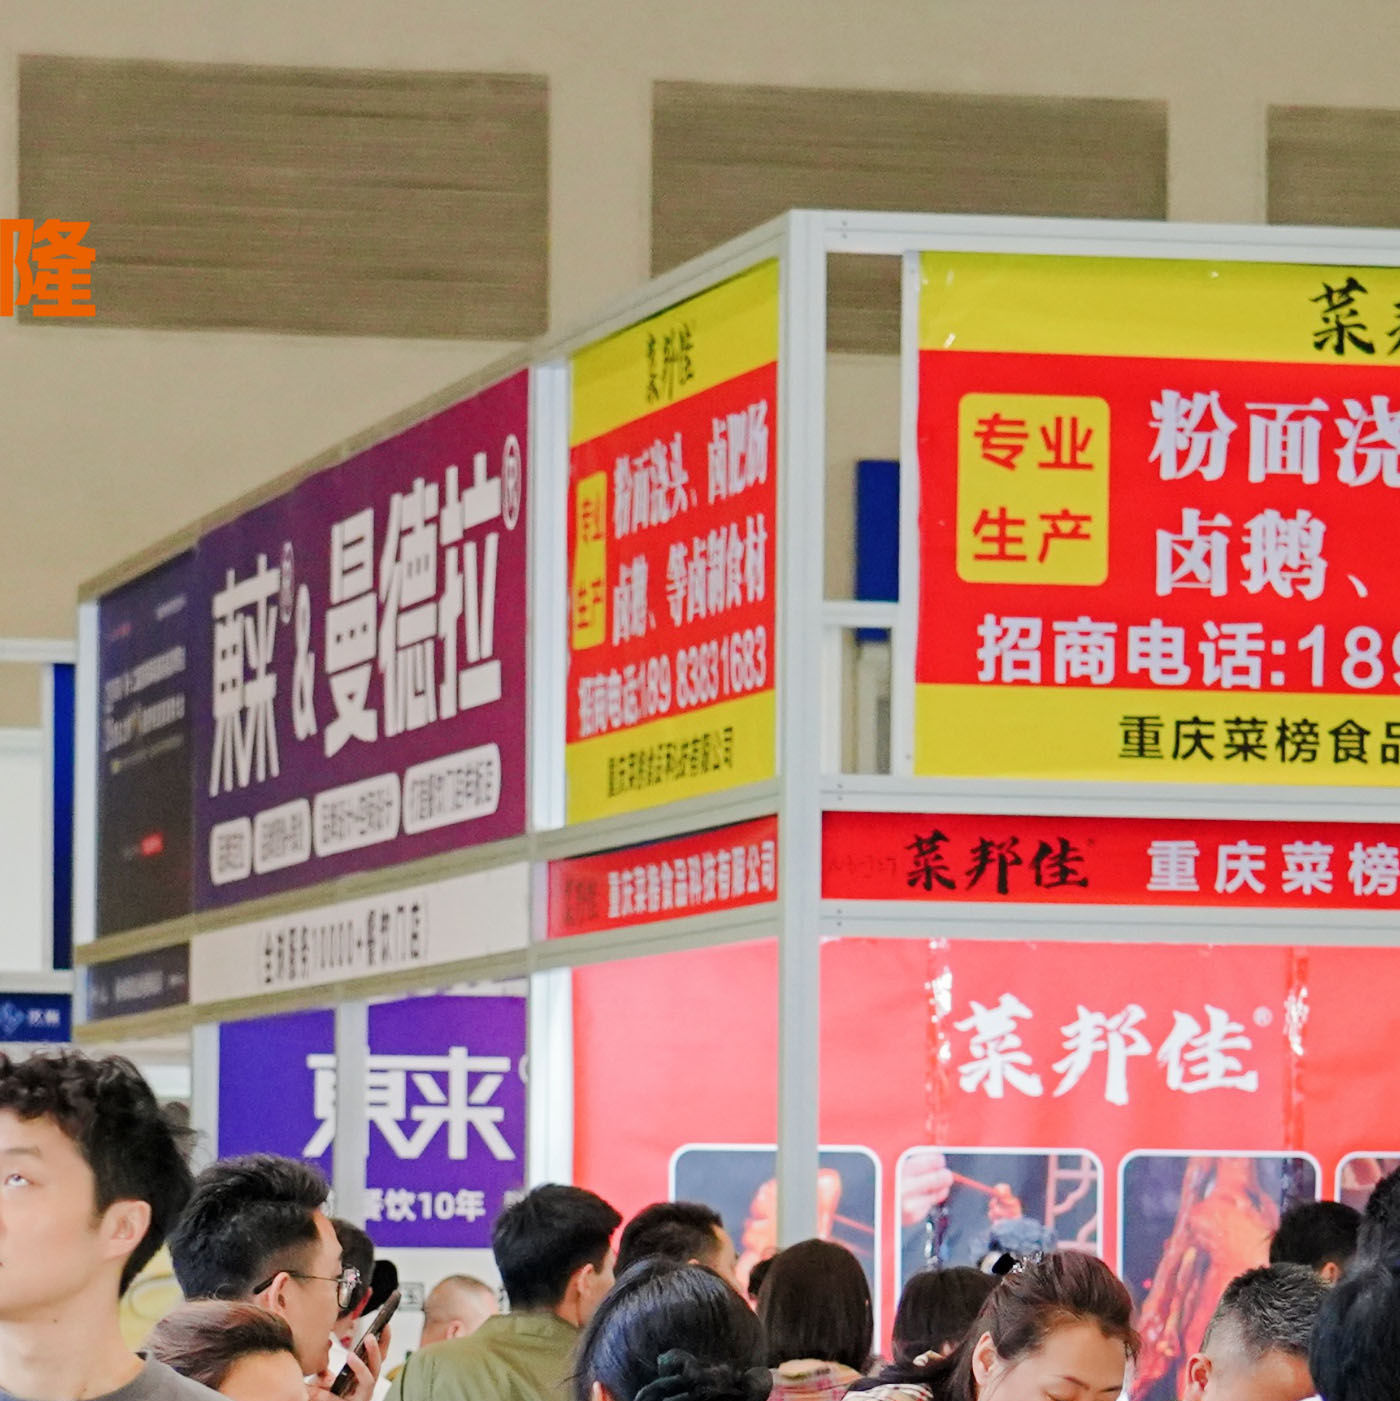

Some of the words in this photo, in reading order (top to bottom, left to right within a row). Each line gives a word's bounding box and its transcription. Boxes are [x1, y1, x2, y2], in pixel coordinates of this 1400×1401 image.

[973, 412, 1094, 472] 专业
[972, 507, 1092, 566] 生产
[324, 452, 501, 758] 曼德拉
[906, 829, 1089, 896] 菜邦佳
[954, 994, 1258, 1105] 菜邦佳
